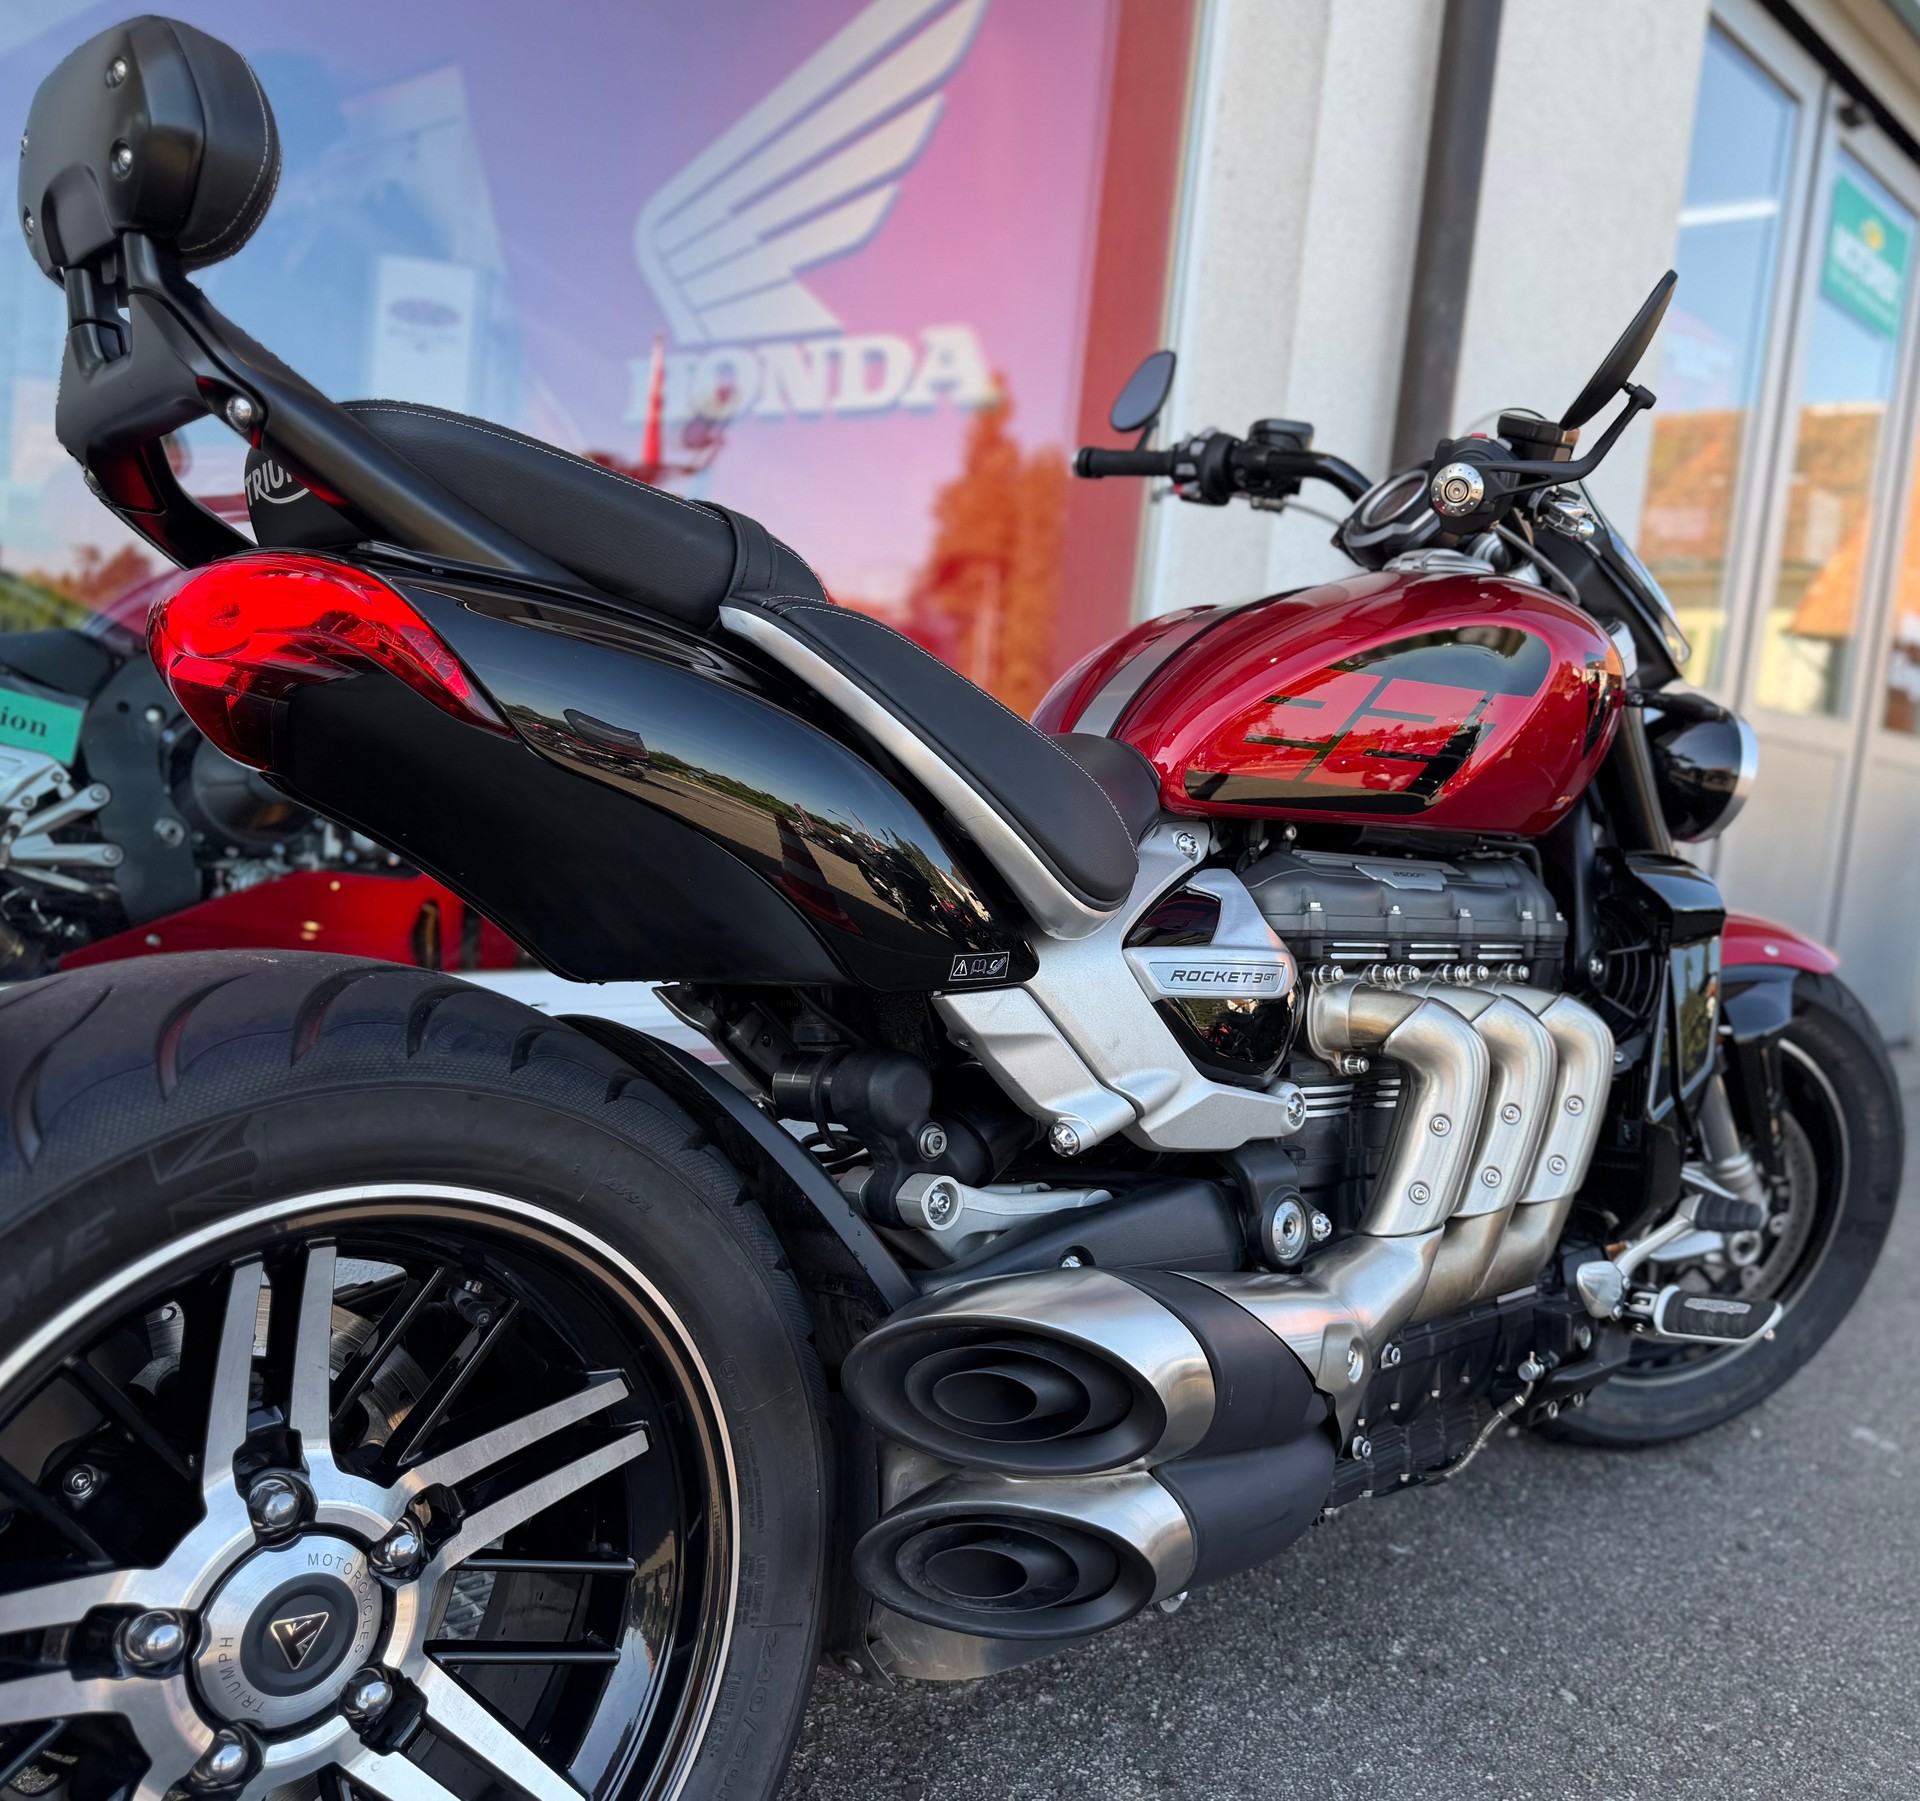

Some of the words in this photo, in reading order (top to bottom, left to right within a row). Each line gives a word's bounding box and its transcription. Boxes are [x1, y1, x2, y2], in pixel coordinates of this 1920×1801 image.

[624, 325, 1001, 424] HONDA
[245, 459, 311, 506] TRIU
[307, 1552, 372, 1654] MOTORCYCLES
[219, 1636, 265, 1713] TRIUMPH
